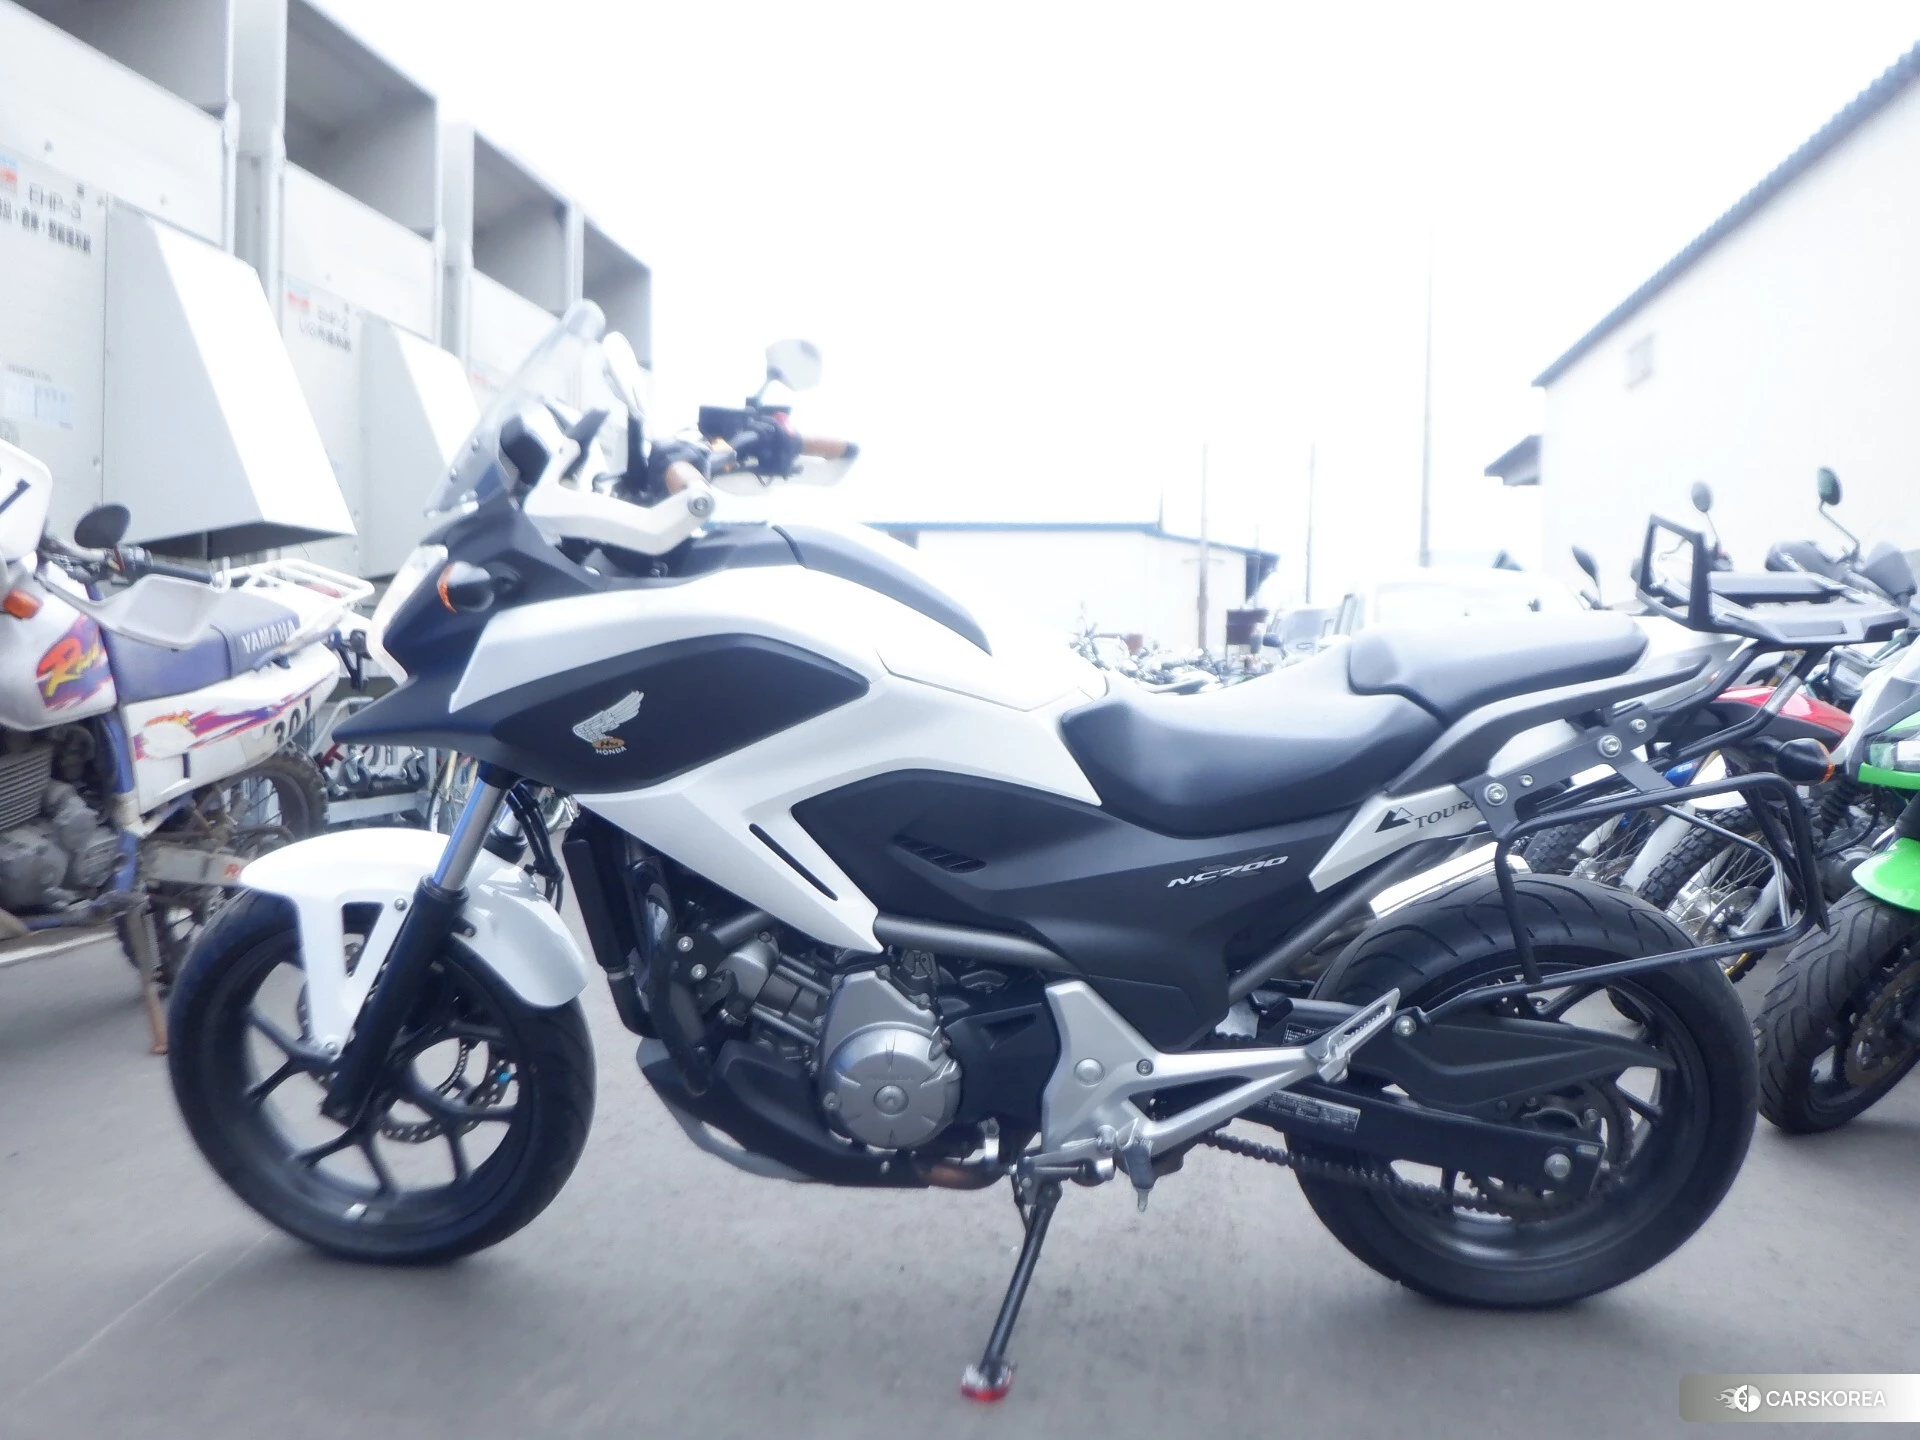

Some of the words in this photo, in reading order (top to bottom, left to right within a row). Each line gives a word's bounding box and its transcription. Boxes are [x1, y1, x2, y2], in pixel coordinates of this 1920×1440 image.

[240, 619, 297, 654] YAMAHA
[595, 745, 627, 756] HONDA
[1167, 855, 1289, 888] NC700
